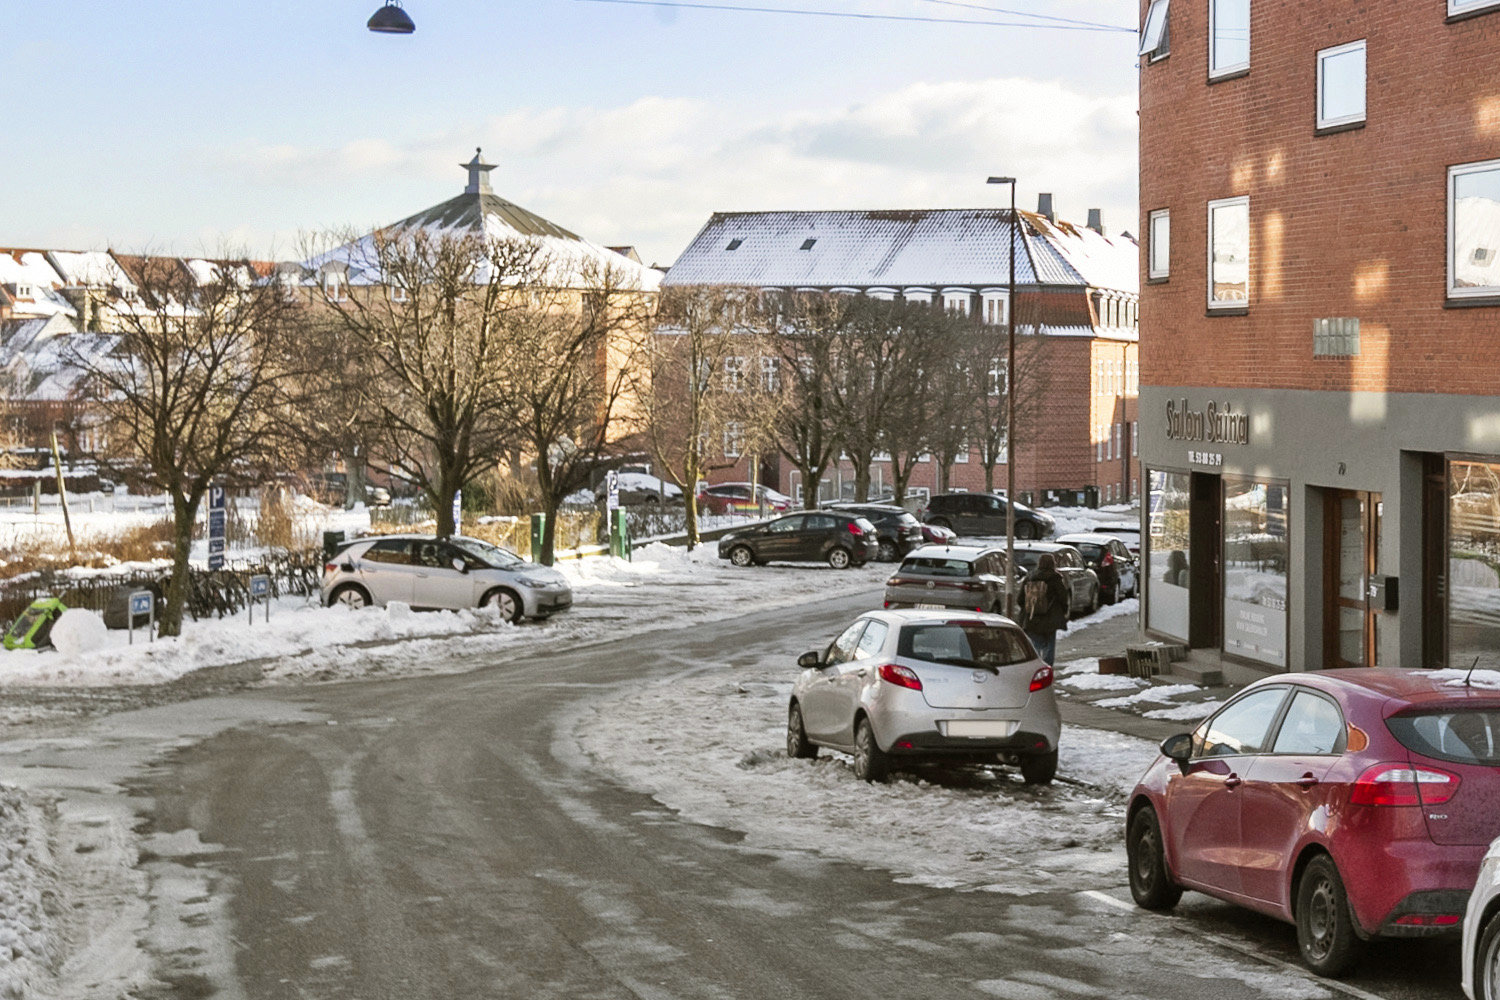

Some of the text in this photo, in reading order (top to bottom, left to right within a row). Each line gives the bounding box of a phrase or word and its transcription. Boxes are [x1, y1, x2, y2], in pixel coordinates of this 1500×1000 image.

[1166, 398, 1249, 445] Salon Saina
[213, 487, 223, 507] P
